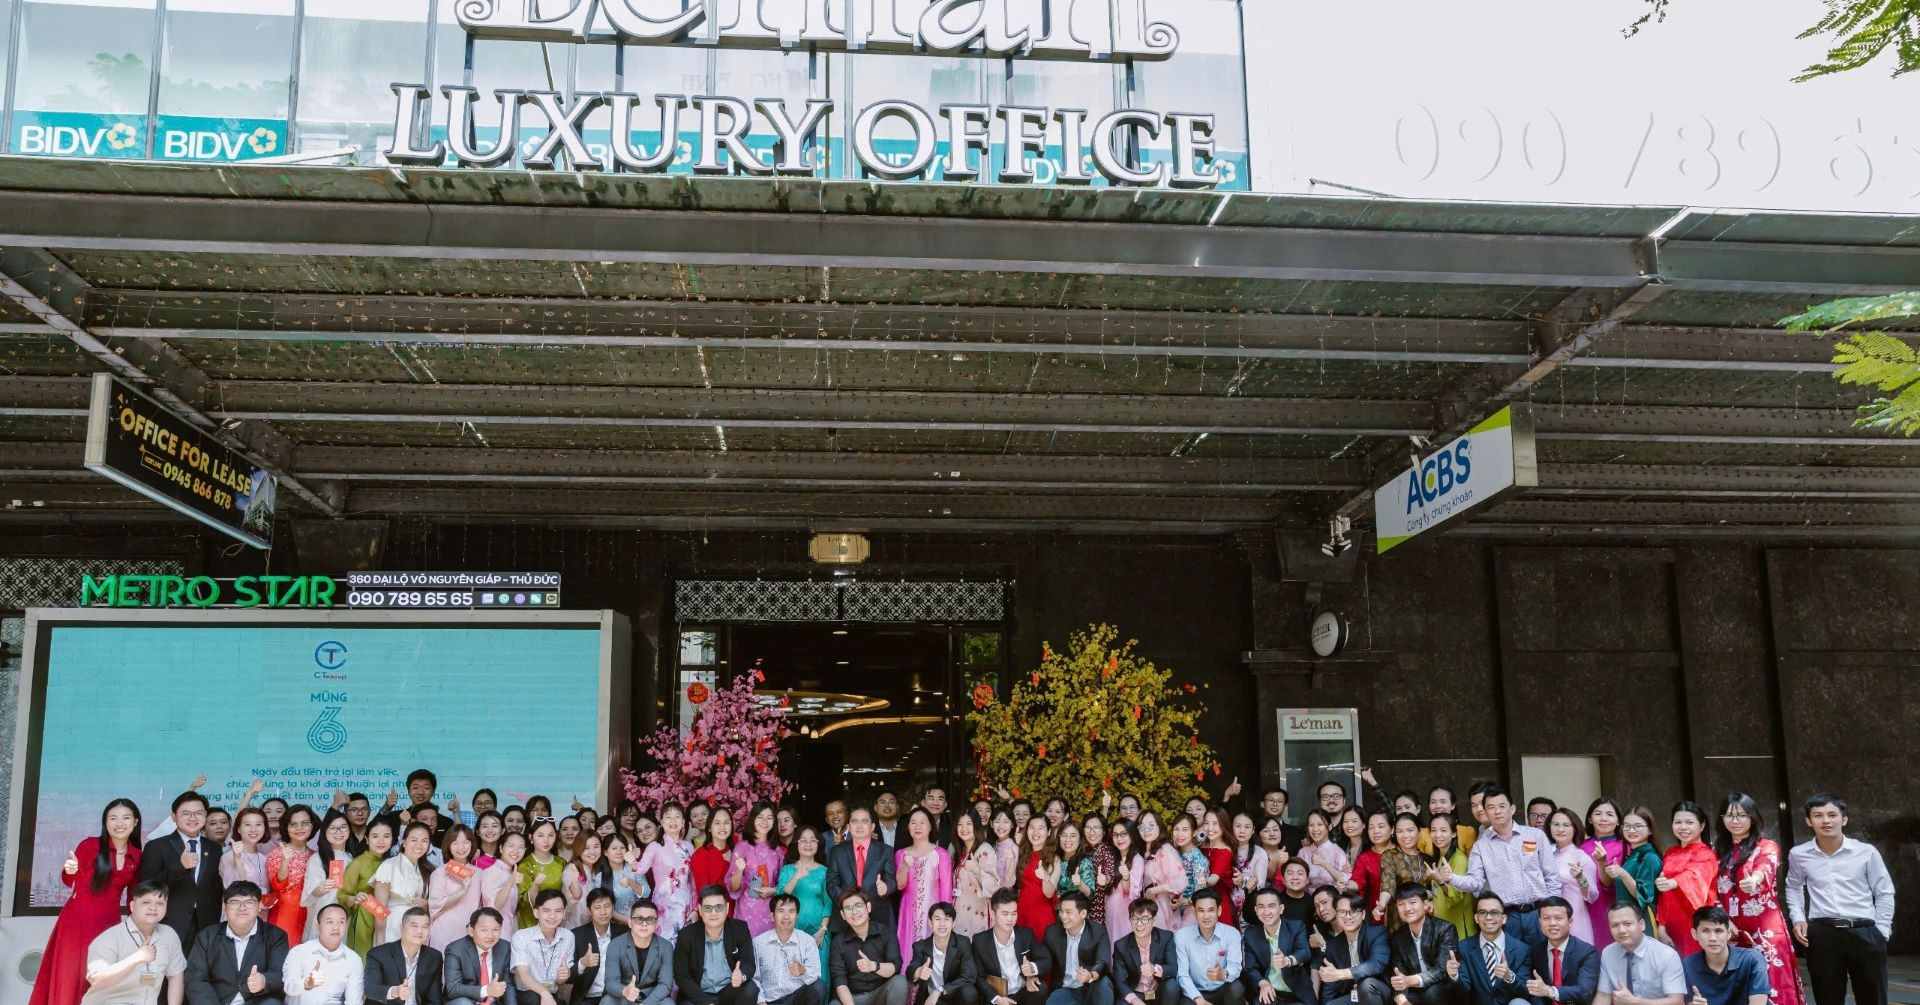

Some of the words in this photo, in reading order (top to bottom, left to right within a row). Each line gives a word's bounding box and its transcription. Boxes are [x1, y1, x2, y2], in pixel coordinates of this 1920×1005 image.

[20, 125, 109, 155] BIDV
[164, 130, 250, 160] BIDV
[383, 82, 834, 176] LUXURY
[852, 100, 1221, 189] OFFICE
[120, 407, 179, 456] OFFICE
[180, 440, 210, 474] FOR
[212, 459, 252, 497] LEASE
[163, 462, 191, 488] 0945
[193, 478, 212, 499] 866
[214, 489, 231, 509] 878
[1406, 438, 1471, 515] ACBS
[80, 574, 220, 608] METRO
[233, 574, 337, 608] STAR
[348, 592, 384, 606] 090
[388, 592, 421, 606] 789
[424, 592, 447, 606] 65
[450, 592, 473, 606] 65
[349, 574, 371, 584] 360
[372, 574, 392, 586] ĐẠI
[393, 573, 409, 586] LỘ
[410, 573, 427, 584] VÕ
[428, 573, 473, 584] NGUYÊN
[475, 573, 501, 584] GIÁP
[510, 572, 532, 584] THỦ
[533, 573, 558, 584] ĐỨC
[306, 705, 348, 754] 6
